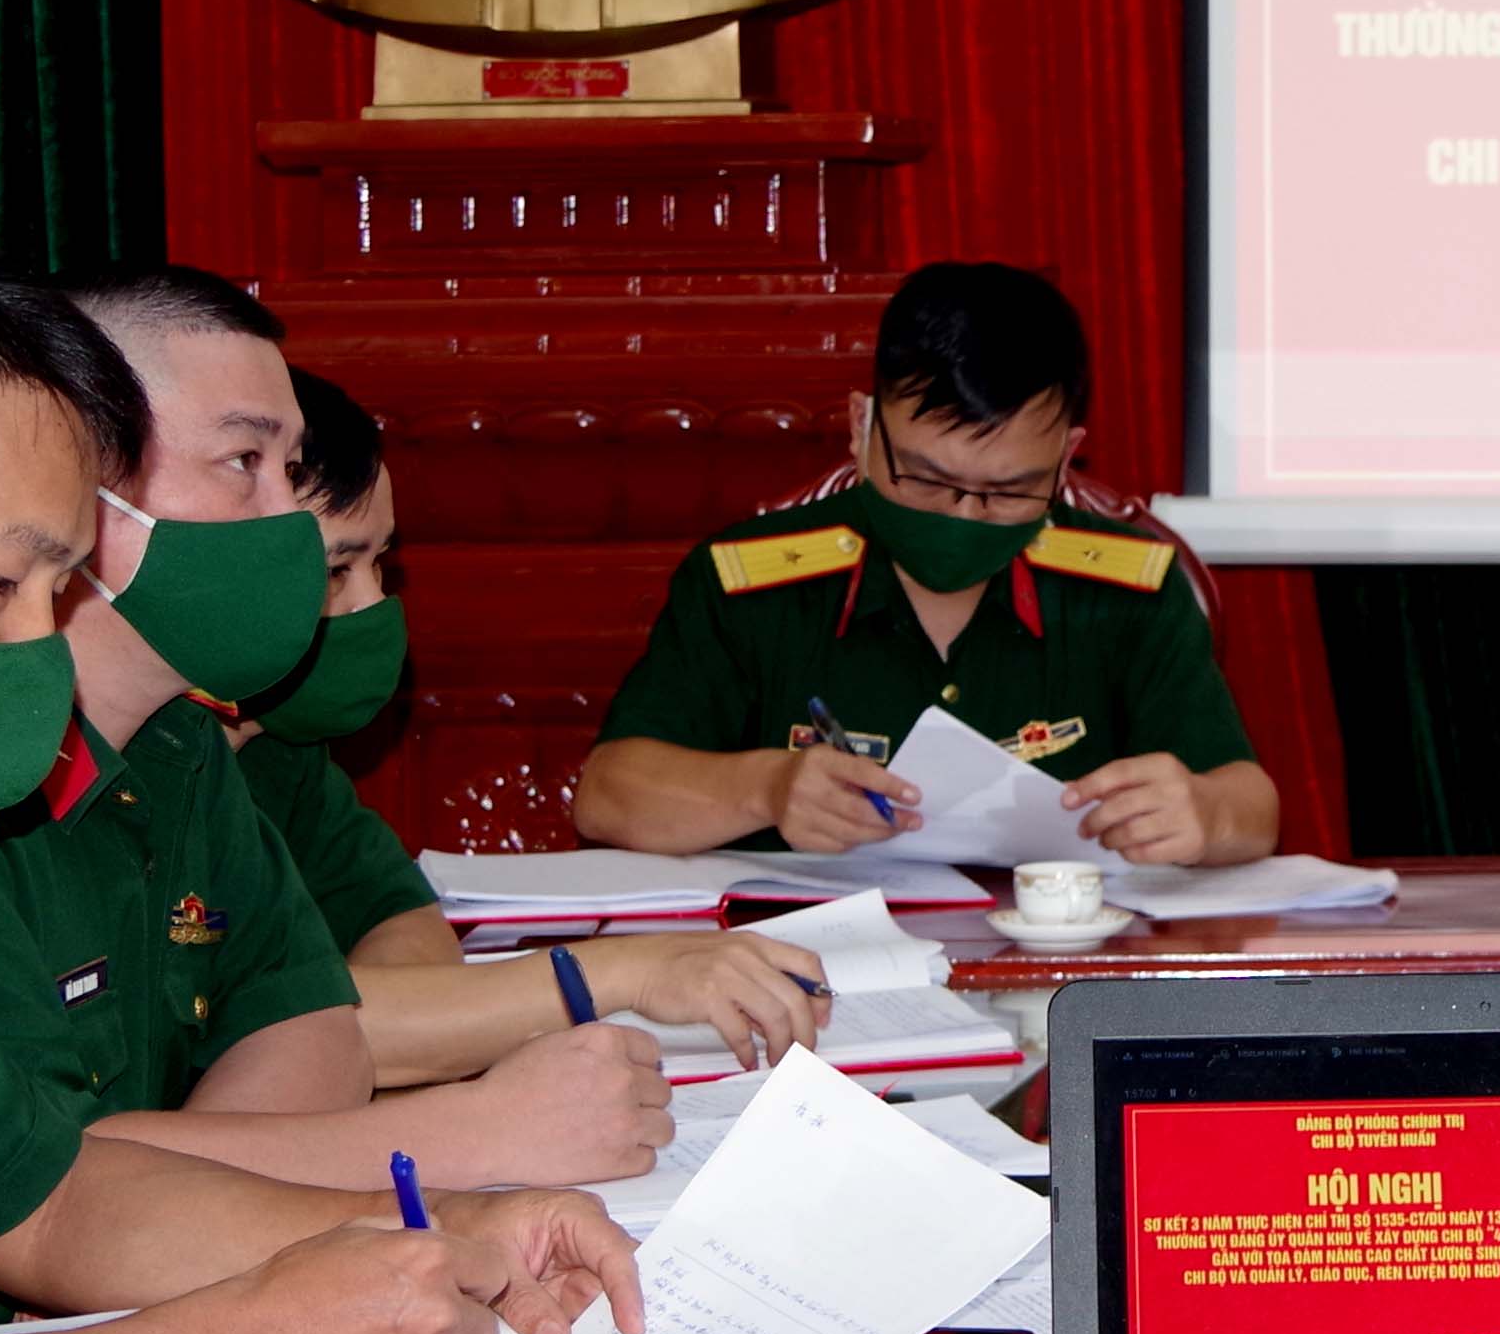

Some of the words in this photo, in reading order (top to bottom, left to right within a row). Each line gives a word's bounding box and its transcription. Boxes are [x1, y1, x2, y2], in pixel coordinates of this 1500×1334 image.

[1427, 139, 1499, 185] CHI
[1308, 1168, 1358, 1212] HỘI
[1369, 1172, 1442, 1210] NGHỊ
